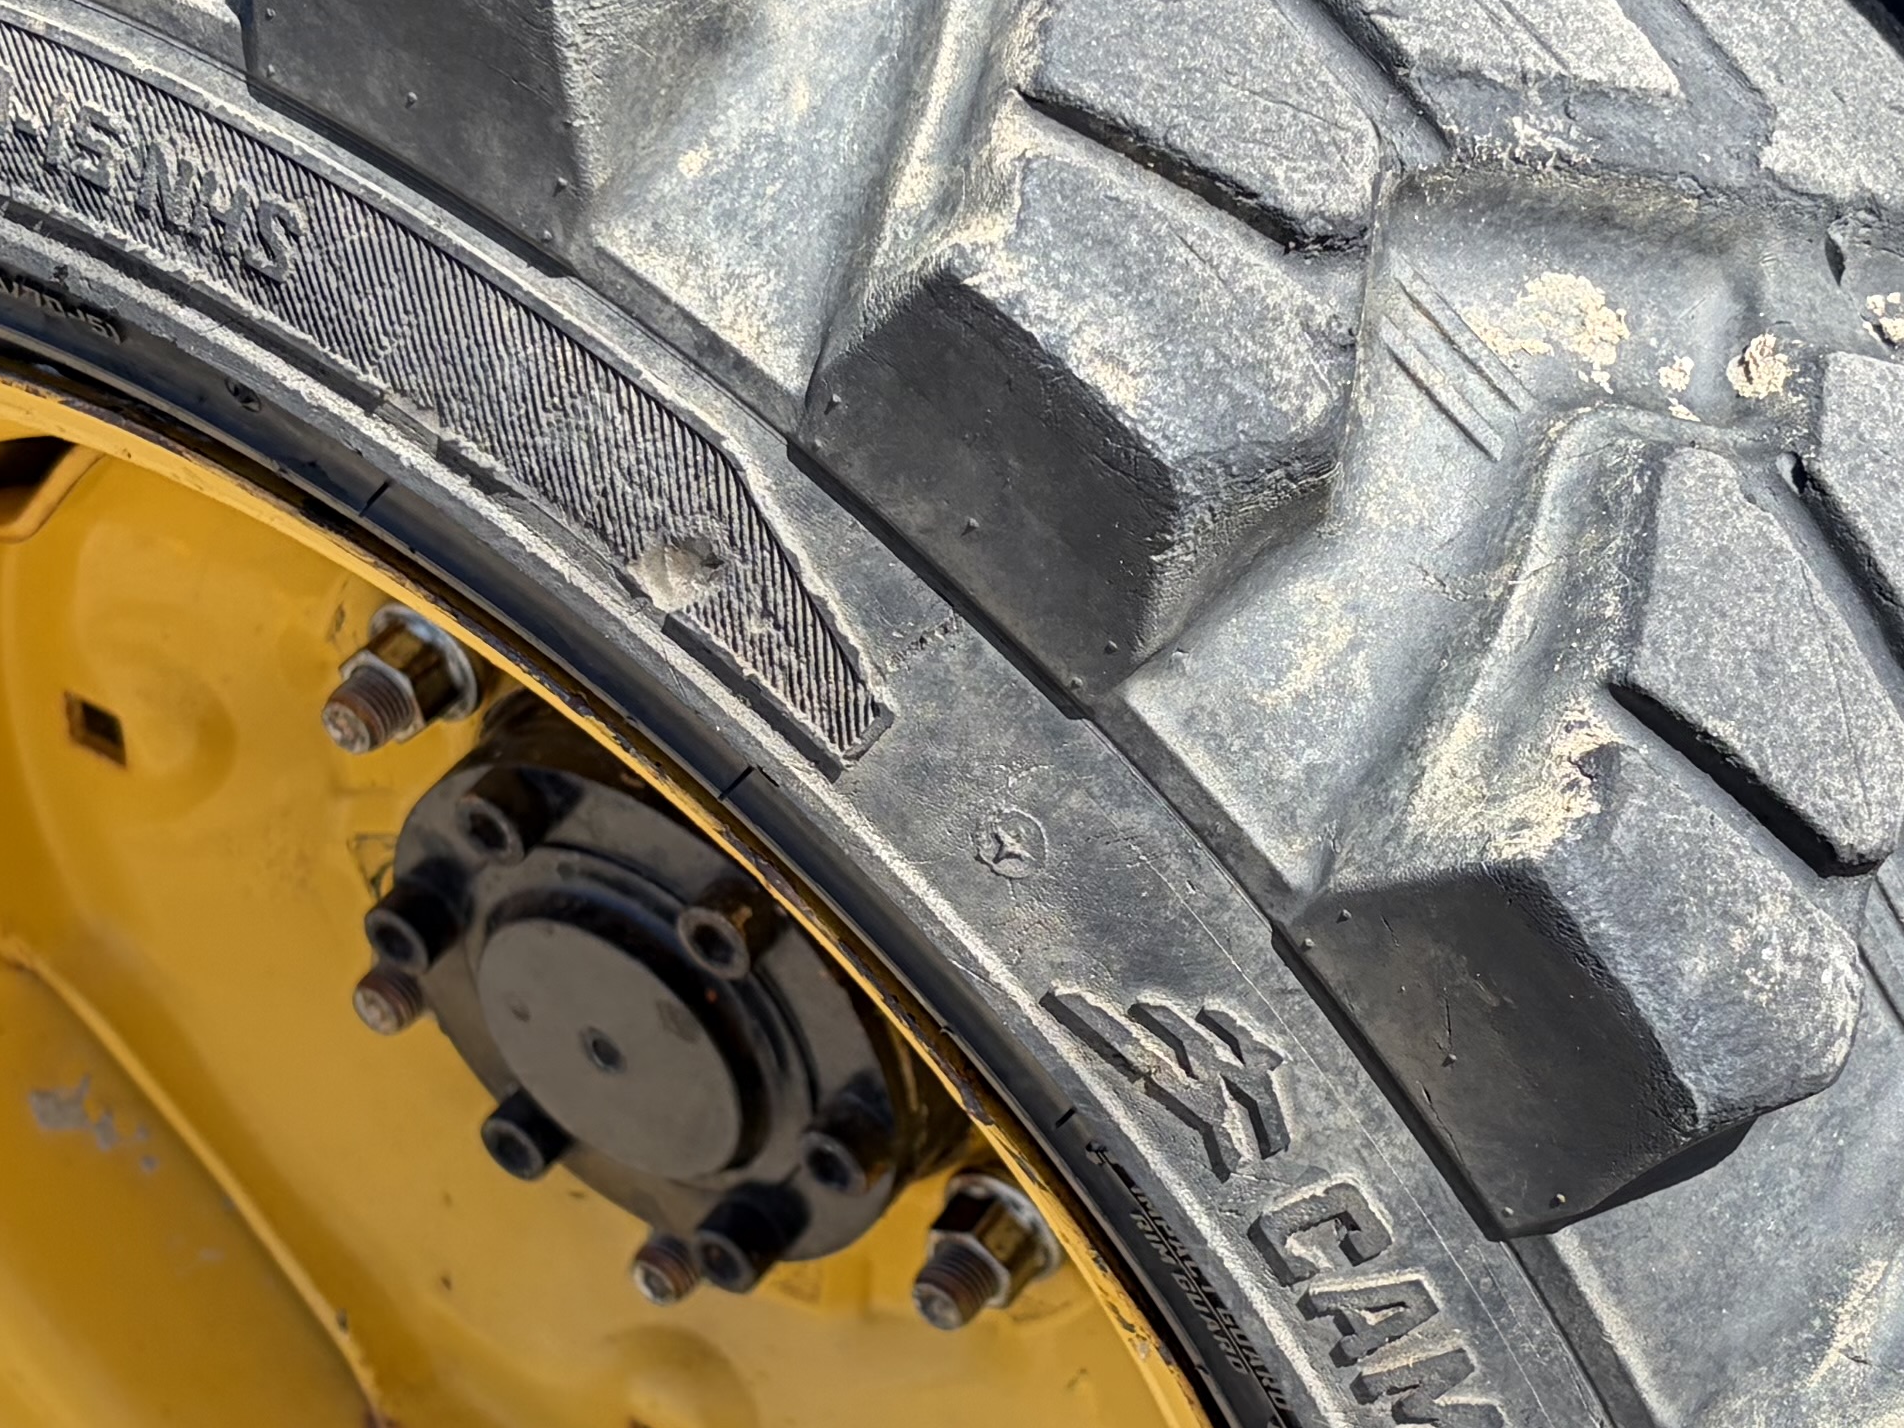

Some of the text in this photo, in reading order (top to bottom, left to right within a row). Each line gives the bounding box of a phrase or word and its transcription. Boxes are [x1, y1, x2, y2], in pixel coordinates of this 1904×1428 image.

[130, 137, 308, 285] NHS
[1130, 1210, 1253, 1376] RIM GUARD
